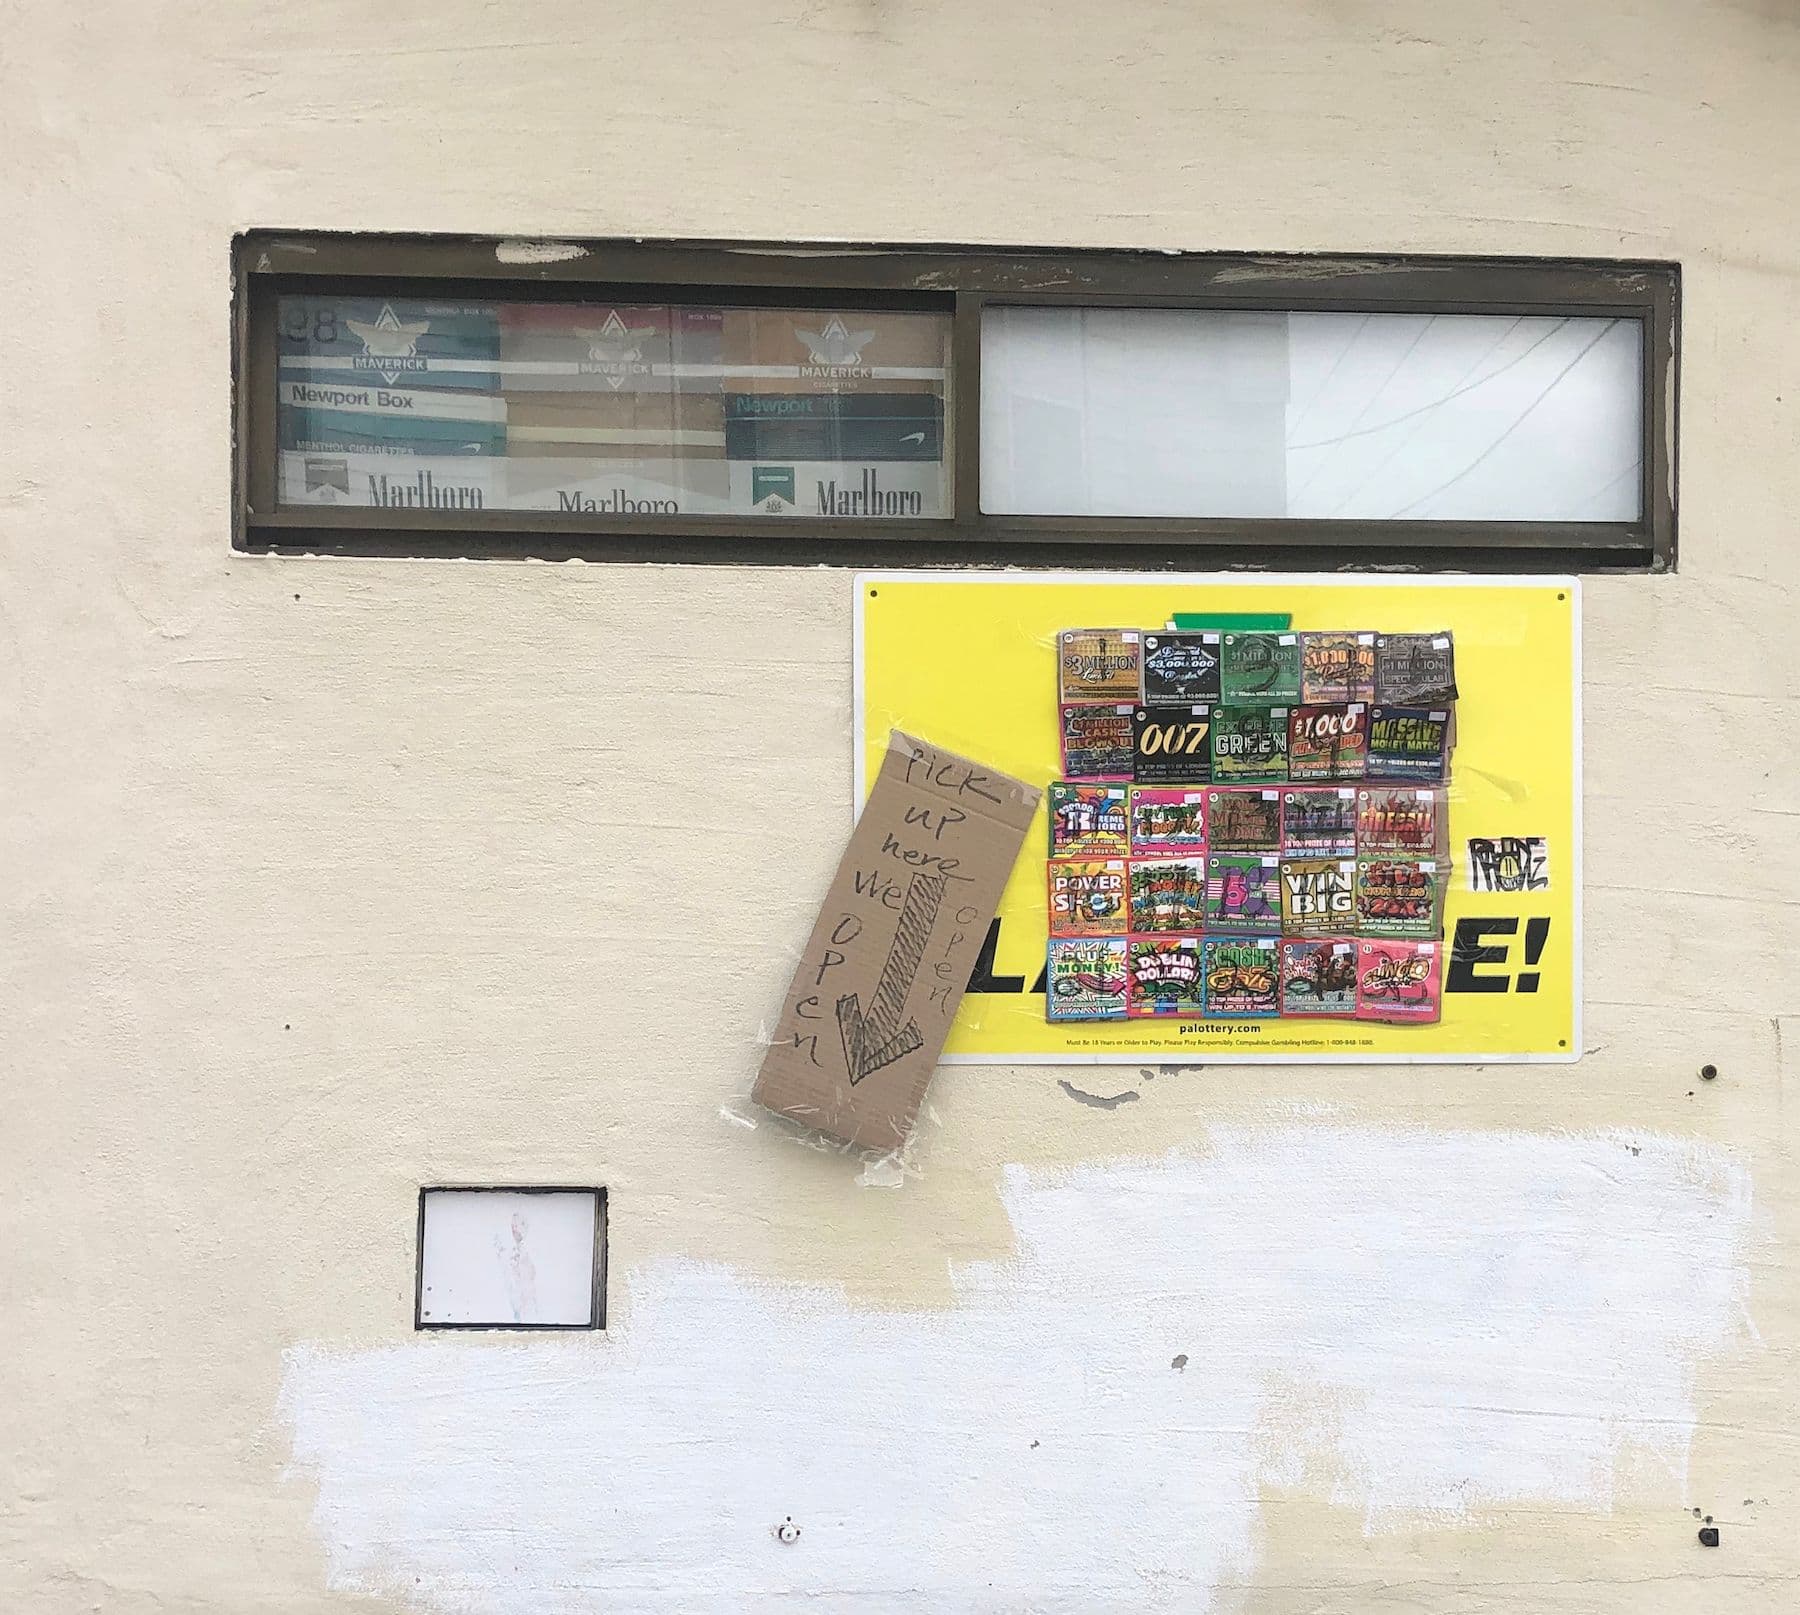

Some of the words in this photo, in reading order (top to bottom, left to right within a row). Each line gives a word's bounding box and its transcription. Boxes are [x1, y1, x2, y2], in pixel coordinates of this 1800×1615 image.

[355, 358, 424, 370] MAVERICK
[802, 367, 869, 378] MAVERICK
[292, 385, 370, 406] Newport
[377, 391, 414, 409] Box
[736, 397, 814, 414] Newport
[296, 440, 344, 453] MENTHOL
[368, 470, 483, 509] Marlboro
[816, 467, 922, 516] Marlboro
[556, 488, 679, 513] Marlboro
[1397, 660, 1444, 670] MIION
[1385, 675, 1444, 684] SPECTULAR
[1295, 712, 1357, 738] $1,000
[1371, 717, 1441, 741] MASSIVE
[1140, 723, 1209, 756] 007
[1215, 733, 1287, 754] GREEN
[1371, 739, 1404, 749] MONEY
[1407, 740, 1440, 750] MATCH
[881, 833, 975, 881] here
[1055, 874, 1122, 891] POWER
[1286, 872, 1352, 894] WIN
[1054, 892, 1123, 912] SHOT
[1291, 892, 1352, 914] BIG
[1062, 950, 1108, 962] PLUS
[1137, 953, 1198, 969] DUBLIN
[1216, 946, 1267, 967] CASH
[1057, 963, 1121, 973] MONEY!
[1179, 1024, 1261, 1035] palottery.com
